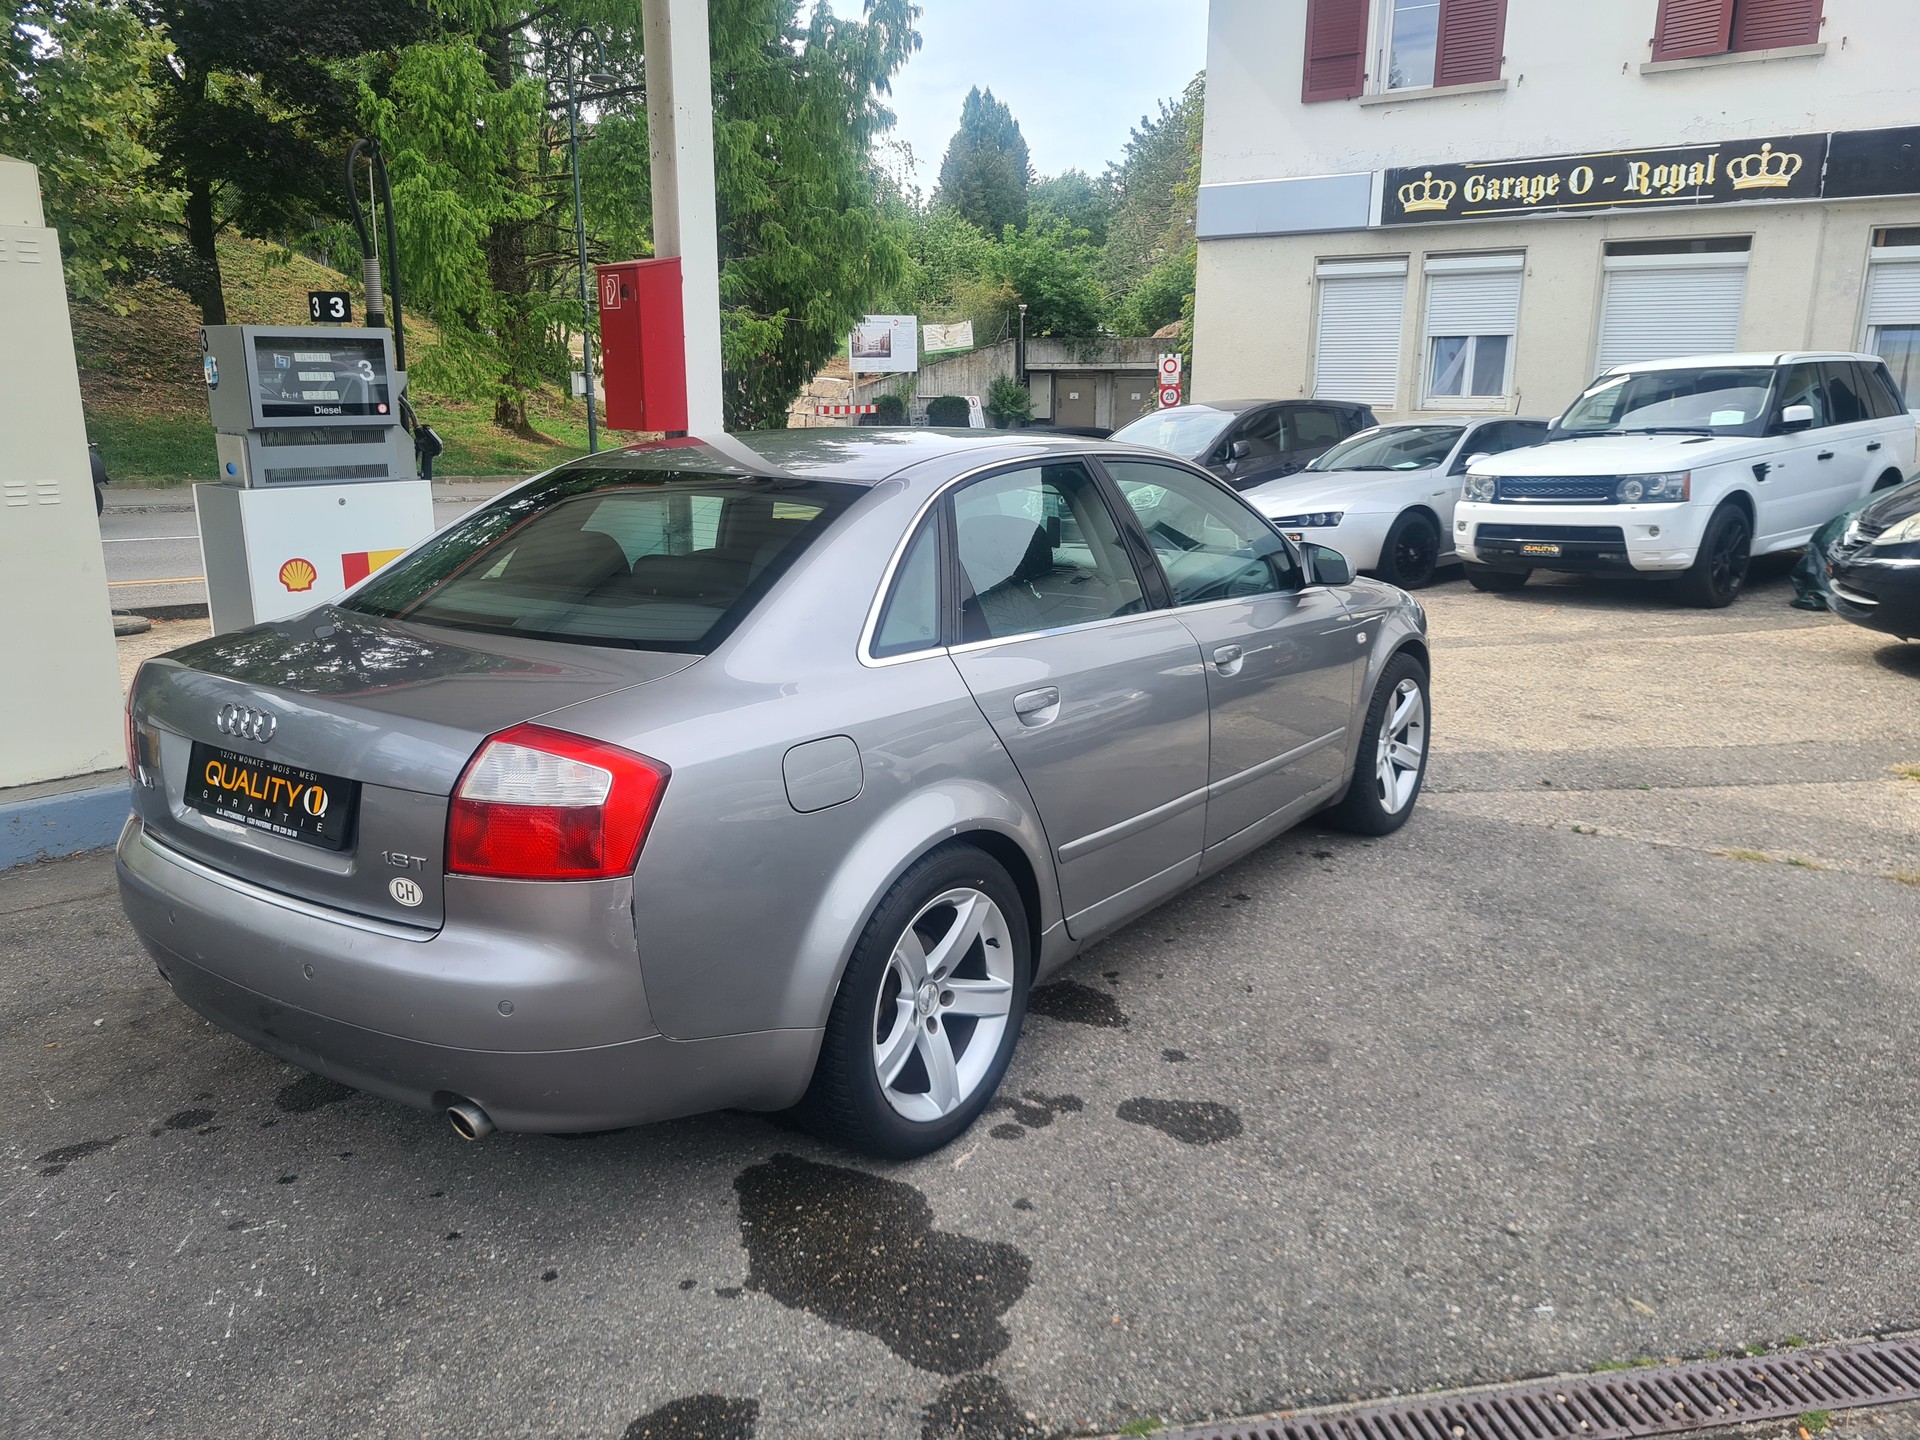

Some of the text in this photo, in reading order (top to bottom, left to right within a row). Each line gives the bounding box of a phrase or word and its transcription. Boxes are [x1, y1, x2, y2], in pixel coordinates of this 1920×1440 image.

[1463, 173, 1560, 204] Garage
[1568, 165, 1594, 195] O
[1623, 153, 1719, 195] Royal
[312, 297, 320, 317] 3
[330, 297, 345, 318] 3
[201, 329, 208, 352] 3
[357, 360, 375, 382] 3
[1165, 392, 1175, 401] 20
[314, 406, 342, 415] Diesel
[220, 750, 237, 761] 12/24
[239, 755, 265, 768] MONATE
[272, 764, 290, 775] MOIS
[299, 770, 318, 782] MESI
[205, 760, 304, 808] QUALITY
[202, 789, 323, 832] GARANTIE
[395, 881, 415, 902] CH
